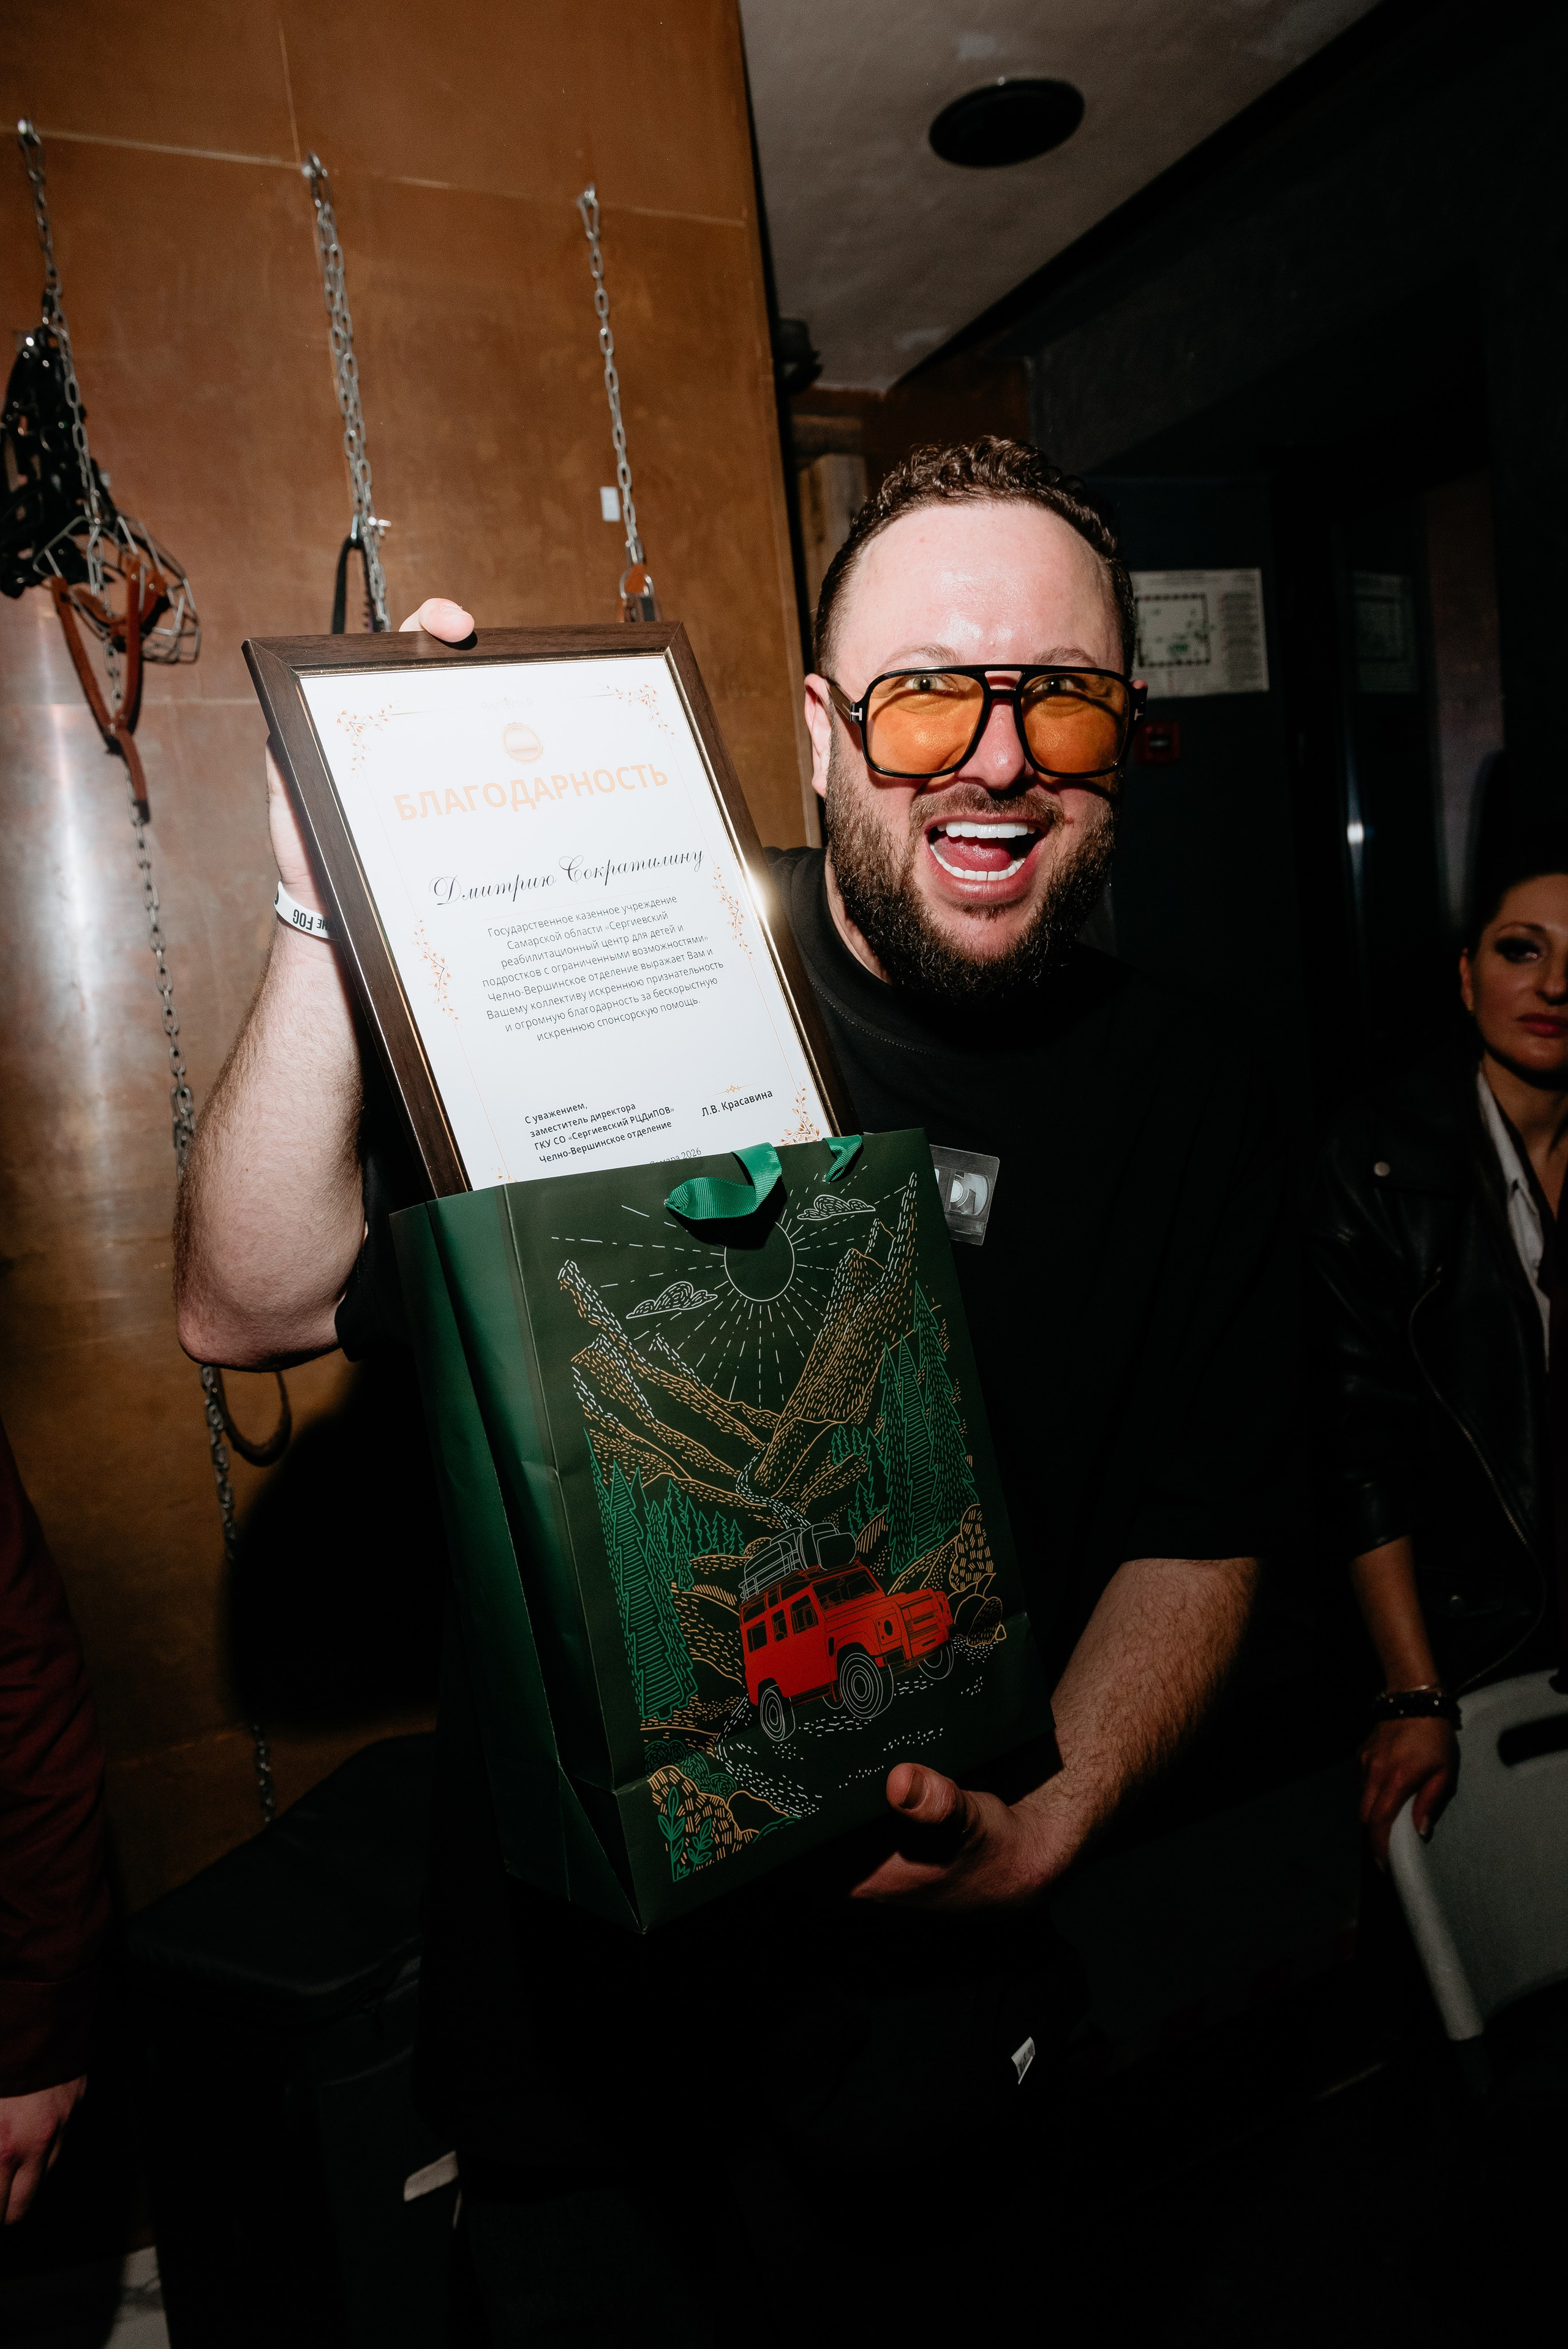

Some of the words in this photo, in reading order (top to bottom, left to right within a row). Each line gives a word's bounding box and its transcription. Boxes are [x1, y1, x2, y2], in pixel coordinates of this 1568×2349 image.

[393, 763, 668, 821] БЛАГОДАРНОСТЬ
[429, 873, 557, 905] Дмитрию
[559, 850, 704, 886] Сократилину
[292, 909, 314, 931] FOG
[316, 918, 328, 931] HE
[487, 915, 574, 937] Государственное
[575, 907, 620, 921] казенное
[621, 896, 677, 915] учреждение
[507, 931, 562, 950] Самарской
[564, 926, 603, 939] области
[605, 911, 669, 930] «Сергиевский
[482, 969, 542, 987] подростков
[551, 951, 630, 973] ограниченными
[631, 935, 708, 957] возможностями»
[500, 940, 600, 970] реабилитационный
[601, 935, 630, 949] центр
[632, 932, 648, 943] для
[650, 924, 676, 940] детей
[486, 1004, 528, 1020] Вашему
[530, 992, 586, 1010] коллективу
[588, 979, 644, 997] искреннюю
[646, 962, 724, 986] признательность
[488, 976, 587, 1001] Челно-Вершинское
[588, 965, 639, 981] отделение
[640, 954, 685, 970] выражает
[687, 950, 706, 960] Вам
[514, 1012, 566, 1030] огромную
[567, 996, 639, 1018] благодарность
[641, 992, 652, 1001] за
[652, 978, 718, 998] бескорыстную
[537, 1021, 595, 1041] искреннюю
[597, 1006, 658, 1027] спонсорскую
[660, 998, 701, 1012] помощь.
[524, 1115, 532, 1124] С
[532, 1103, 587, 1125] уважением,
[529, 1117, 589, 1138] заместитель
[590, 1104, 636, 1123] директора
[701, 1104, 721, 1117] Л.В.
[720, 1090, 774, 1112] Красавина
[534, 1139, 551, 1151] ГКУ
[553, 1135, 566, 1145] СО
[568, 1117, 629, 1141] «Сергиевский
[629, 1106, 674, 1124] РЦДиПОВ»
[538, 1134, 626, 1163] Челно-Вершинское
[627, 1121, 673, 1139] отделение
[680, 1147, 702, 1159] 2026
